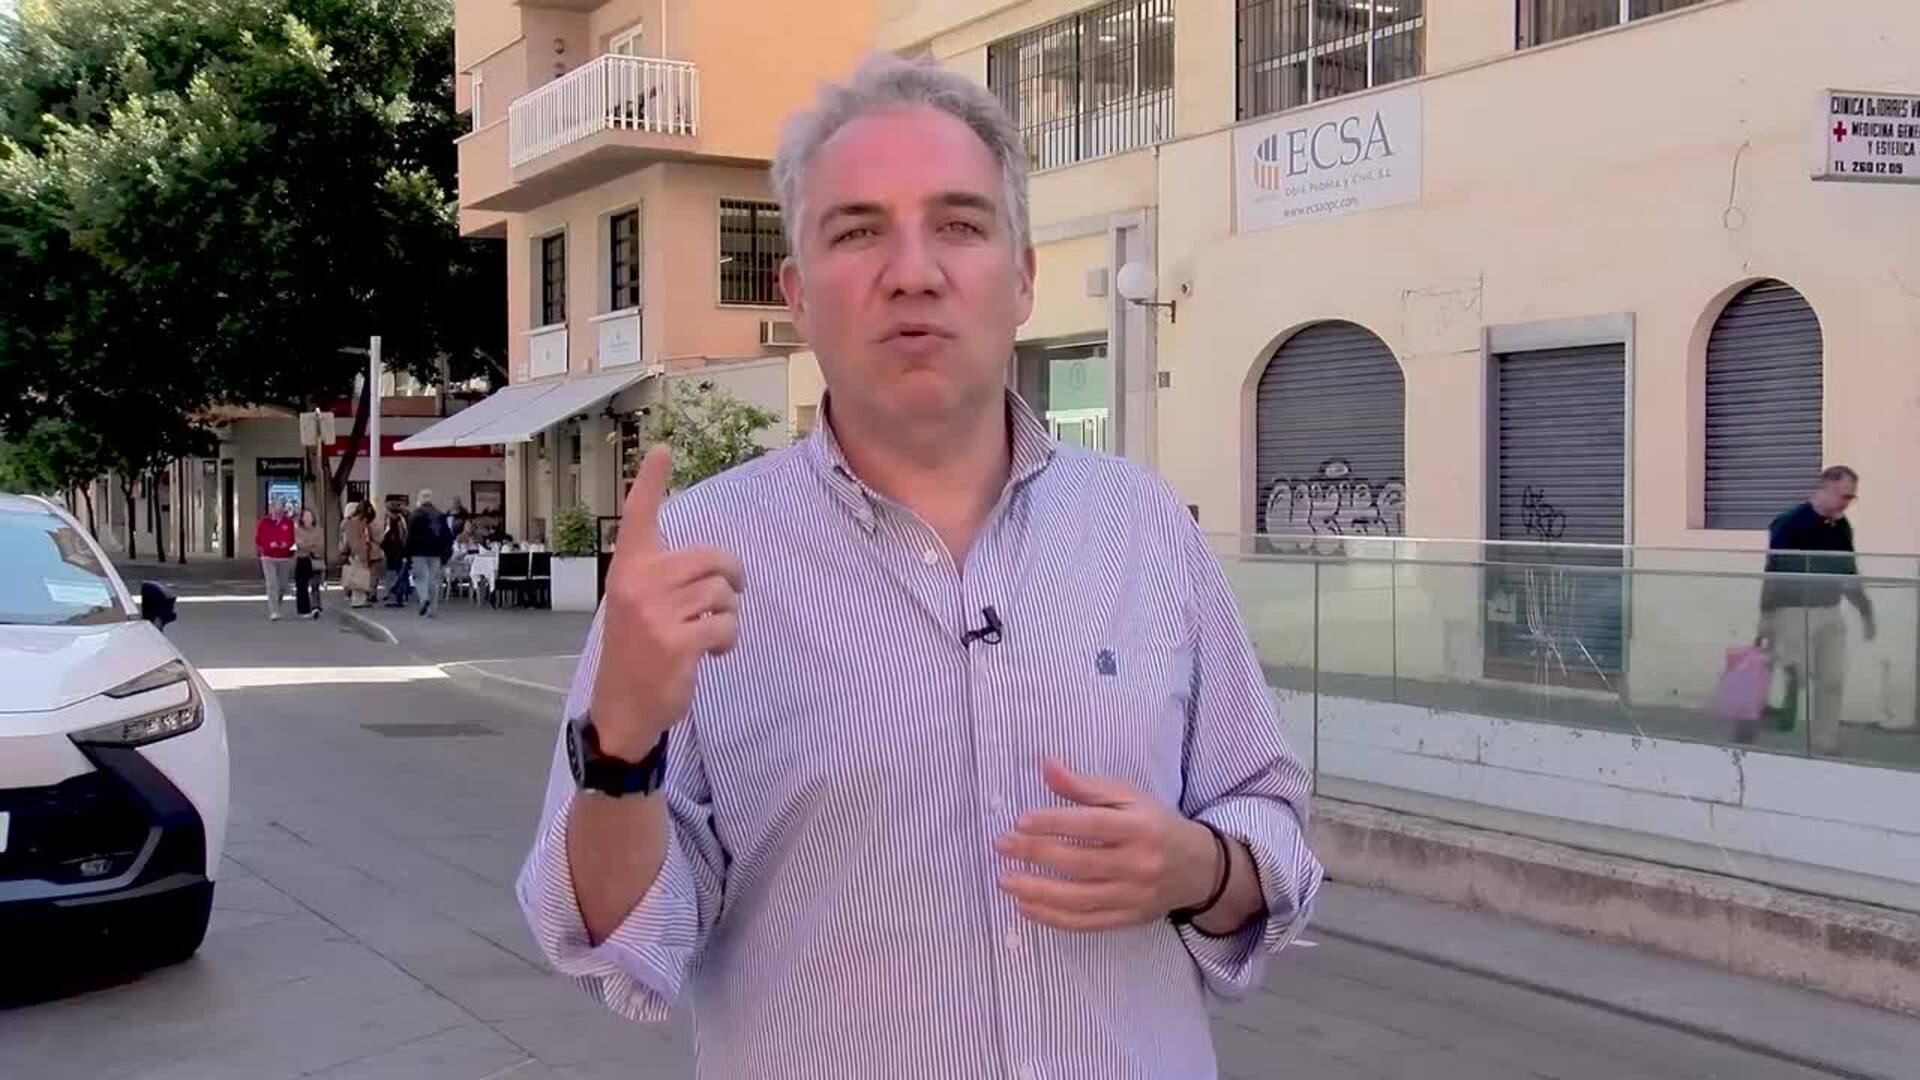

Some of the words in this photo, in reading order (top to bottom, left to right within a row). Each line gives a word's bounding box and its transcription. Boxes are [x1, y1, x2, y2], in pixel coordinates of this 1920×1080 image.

[1852, 121, 1894, 137] MEDICINA
[1286, 110, 1394, 177] ECSA
[1867, 140, 1873, 155] Y
[1876, 141, 1915, 156] ESTETICA
